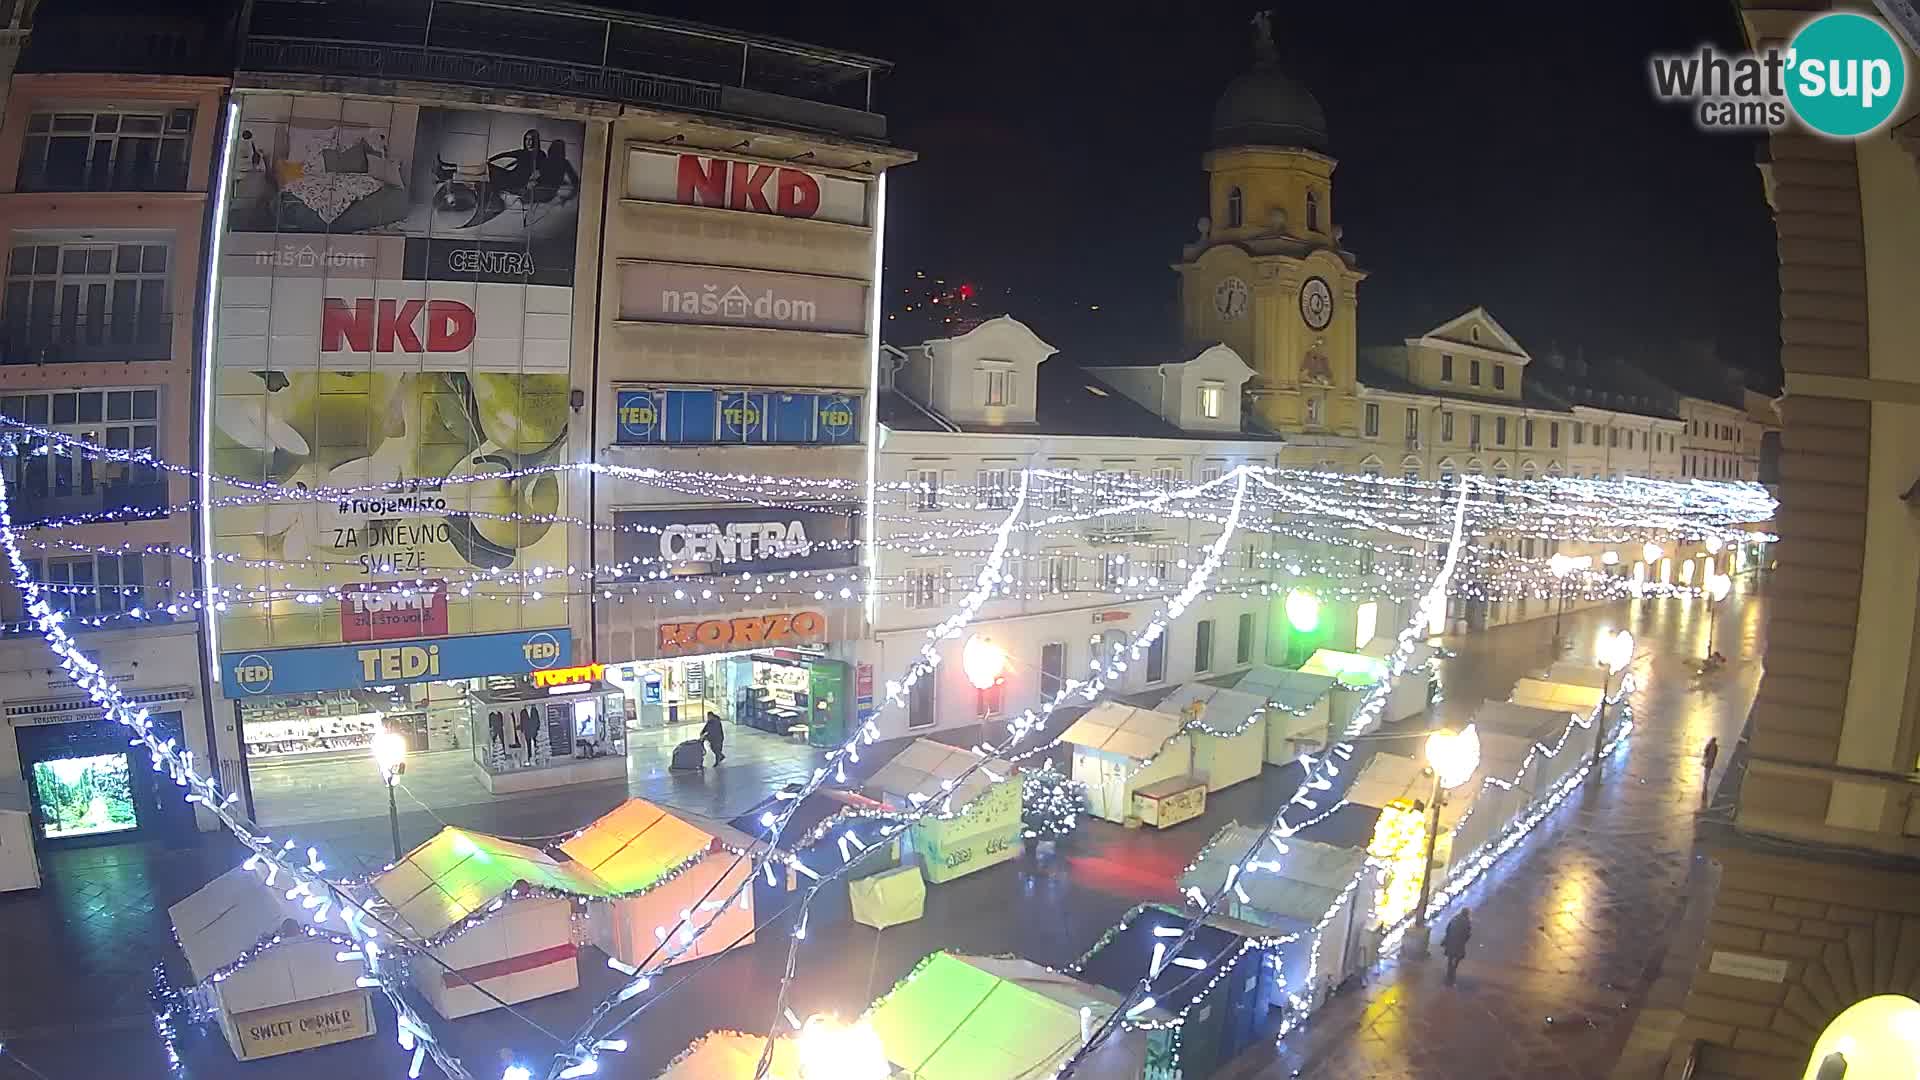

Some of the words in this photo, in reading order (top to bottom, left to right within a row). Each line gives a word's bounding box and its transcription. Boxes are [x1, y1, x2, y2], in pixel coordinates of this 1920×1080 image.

[677, 154, 821, 218] NKD
[255, 245, 295, 267] naš
[318, 246, 367, 268] dom
[449, 249, 535, 275] CENTRA
[662, 284, 718, 315] naš
[753, 290, 816, 323] dom
[320, 298, 477, 353] NKD
[339, 496, 446, 515] #TvojeMisto
[334, 528, 358, 548] ZA
[369, 523, 451, 547] DNEVNO
[660, 520, 811, 564] CENTRA
[352, 588, 435, 613] TOMMY
[660, 611, 825, 652] KORZO
[358, 645, 440, 682] TEDi
[523, 643, 560, 660] TEDi
[234, 667, 274, 684] TEDi
[534, 664, 605, 687] TOMMY
[250, 1020, 293, 1042] SWEET
